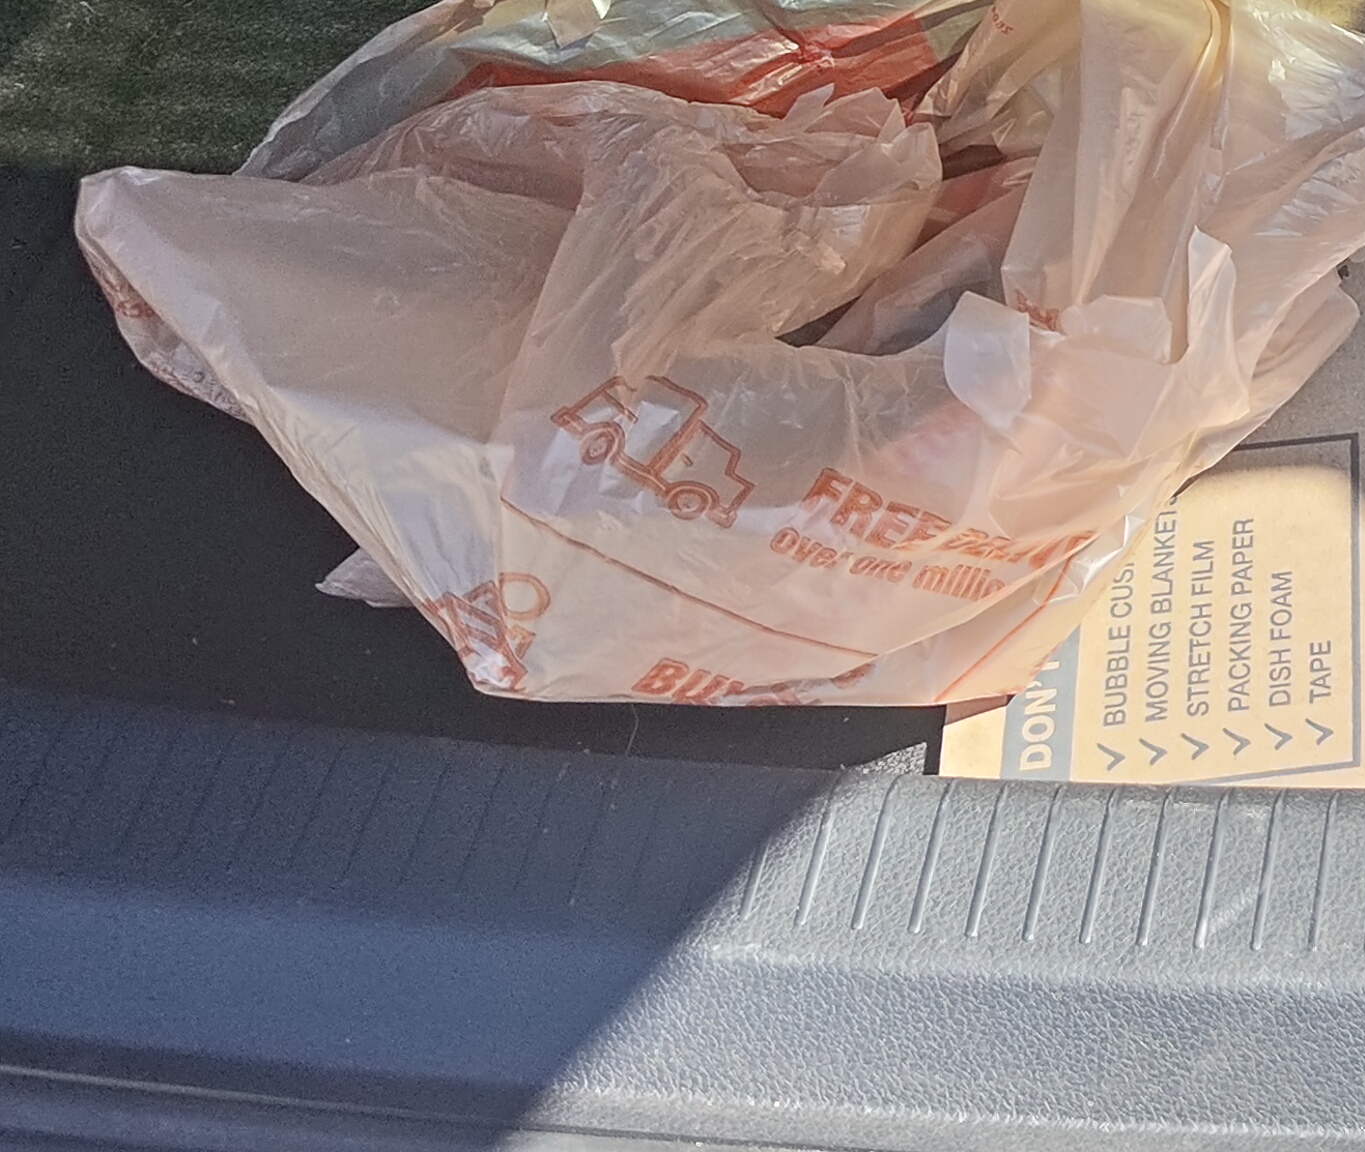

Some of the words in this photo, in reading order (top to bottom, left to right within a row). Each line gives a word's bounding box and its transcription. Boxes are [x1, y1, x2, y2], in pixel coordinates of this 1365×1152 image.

[801, 466, 952, 552] FREE
[848, 555, 912, 583] one
[912, 564, 1006, 602] millio
[1110, 561, 1136, 619] CUS
[1191, 539, 1215, 597] FILM
[1230, 517, 1255, 596] PAPER
[1269, 570, 1294, 641] FOAM
[1103, 624, 1131, 727] BUBBLE
[1145, 621, 1173, 722] MOVING
[1187, 602, 1213, 717] STRETCH
[1227, 601, 1253, 713] PACKING
[1268, 647, 1292, 708] DISH
[1308, 639, 1332, 705] TAPE
